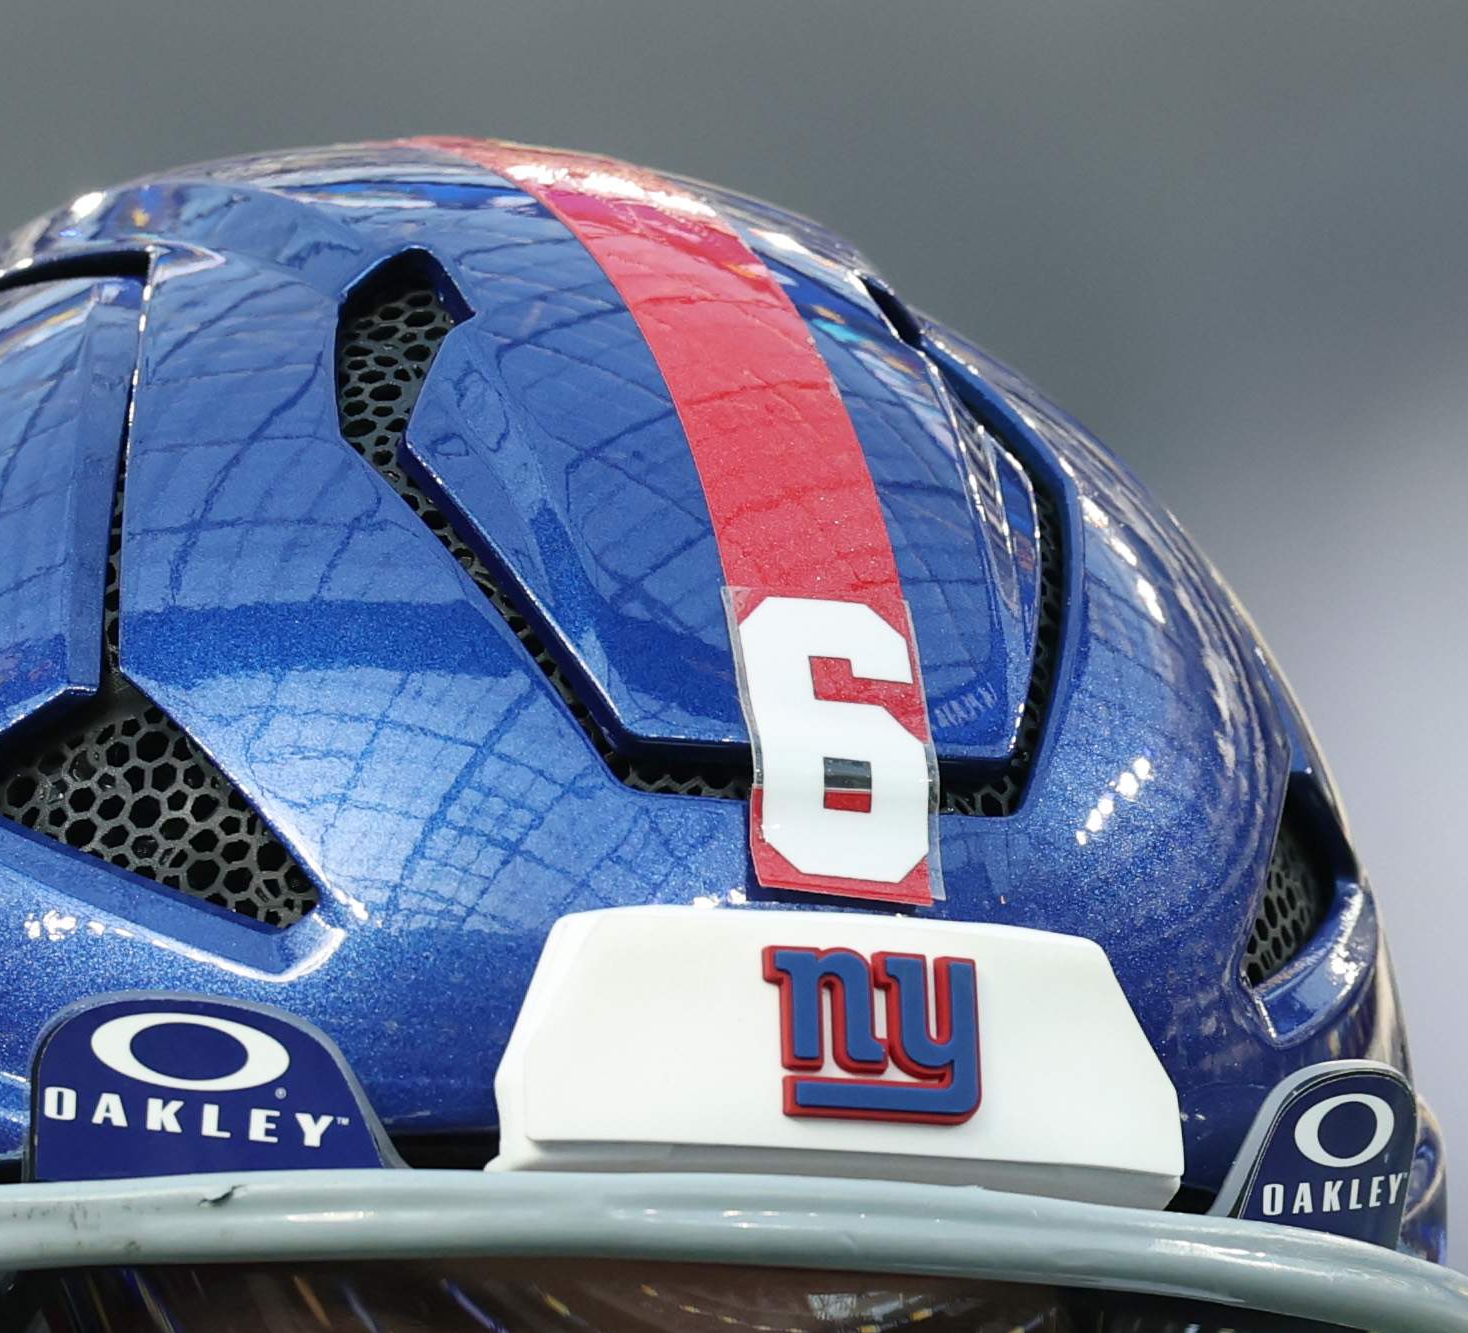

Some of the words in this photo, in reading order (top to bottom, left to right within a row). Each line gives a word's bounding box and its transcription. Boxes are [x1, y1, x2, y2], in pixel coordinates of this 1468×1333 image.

[737, 596, 931, 884] 6
[44, 1086, 334, 1148] OAKLEY
[1262, 1172, 1405, 1216] OAKLEY
